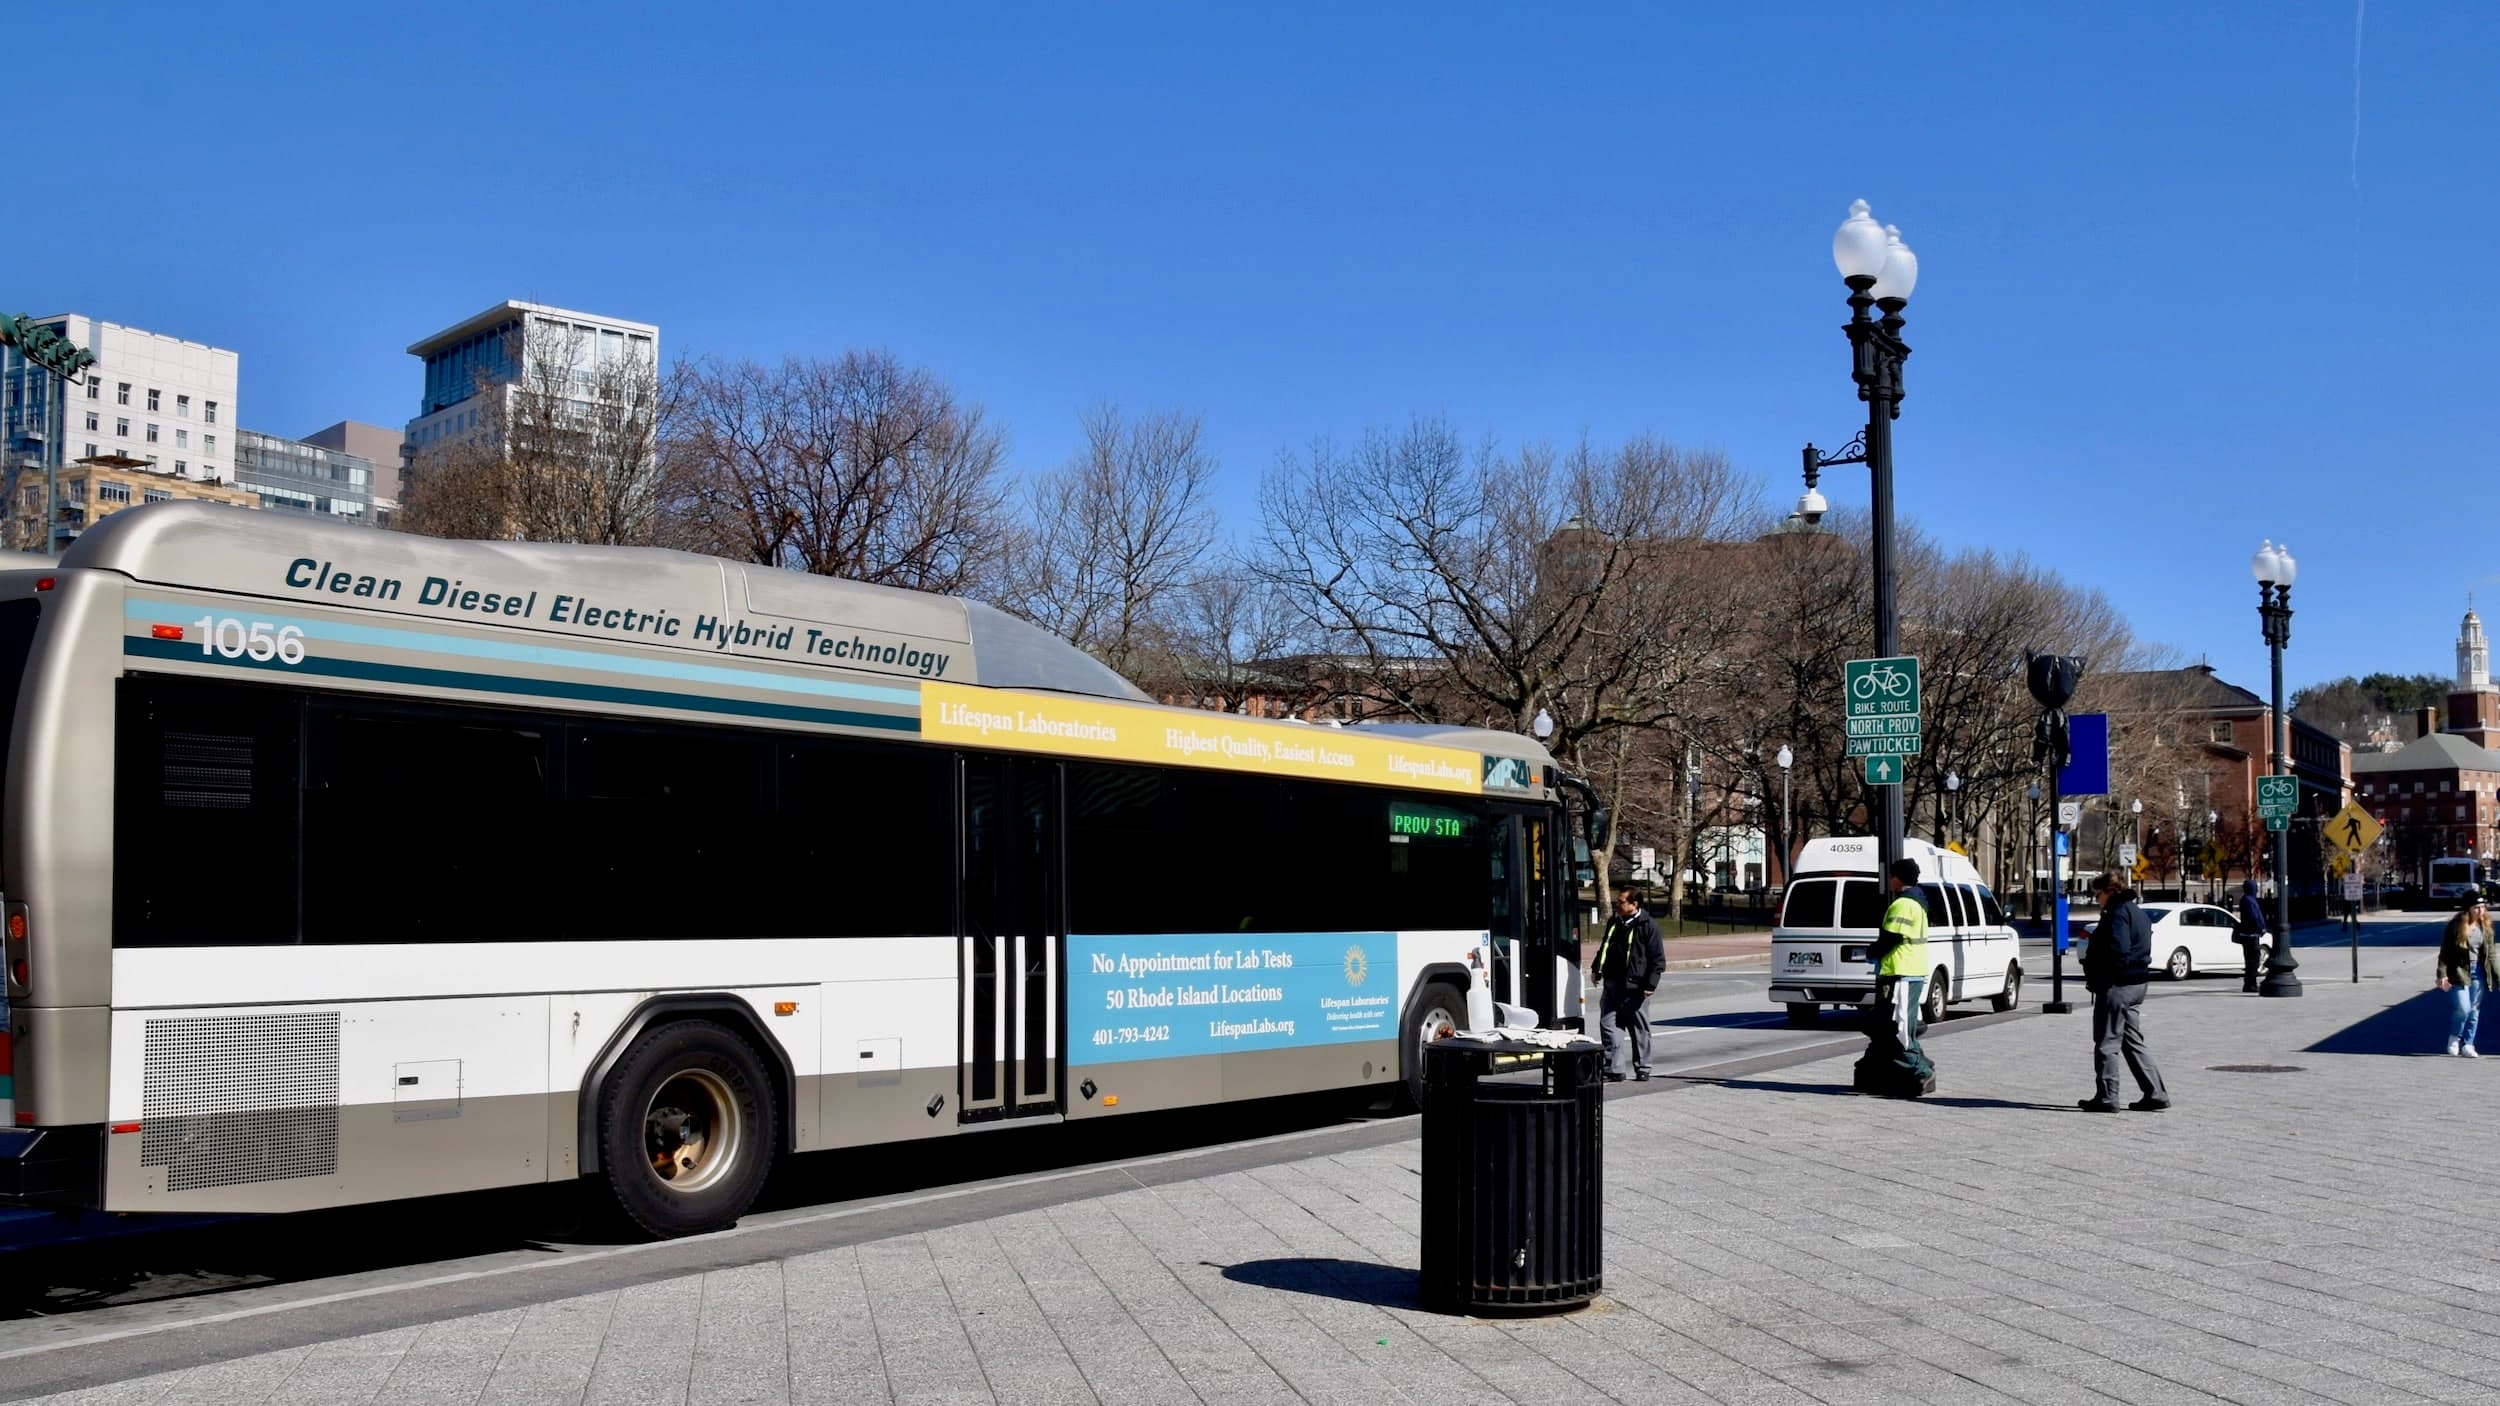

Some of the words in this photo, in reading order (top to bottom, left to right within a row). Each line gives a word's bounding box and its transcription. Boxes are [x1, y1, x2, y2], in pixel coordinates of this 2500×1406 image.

[285, 558, 402, 601] Clean
[418, 576, 538, 618] Diesel
[549, 594, 681, 636] Electric
[693, 614, 794, 650] Hybrid
[806, 629, 950, 677] Technology
[194, 615, 305, 665] 1056
[1855, 702, 1876, 714] BIKE
[1880, 700, 1911, 713] ROUTE
[939, 702, 1014, 734] Lifespan
[1017, 711, 1117, 742] Laboratories
[1850, 719, 1884, 735] NORTH
[1888, 718, 1916, 733] PROV
[1166, 728, 1218, 755] Highest
[1221, 735, 1271, 763] Quality,
[1274, 741, 1315, 763] Easiest
[1318, 745, 1355, 768] Access
[1849, 737, 1918, 753] PAWTUCKET
[1388, 754, 1473, 785] LifespanLabs.org
[1394, 815, 1430, 834] PROV
[1435, 817, 1461, 836] STA
[1830, 844, 1863, 853] 40359
[1091, 953, 1114, 973] No
[1118, 952, 1210, 978] Appointment
[1214, 950, 1233, 969] for
[1236, 949, 1259, 969] Lab
[1262, 949, 1293, 968] Tests
[1106, 990, 1124, 1009] 50
[1127, 987, 1174, 1008] Rhode
[1177, 985, 1218, 1006] Island
[1221, 984, 1282, 1004] Locations
[1320, 997, 1351, 1009] Lifespan
[1092, 1025, 1169, 1045] 401-793-4242
[1210, 1018, 1295, 1039] LifespanLabs.org
